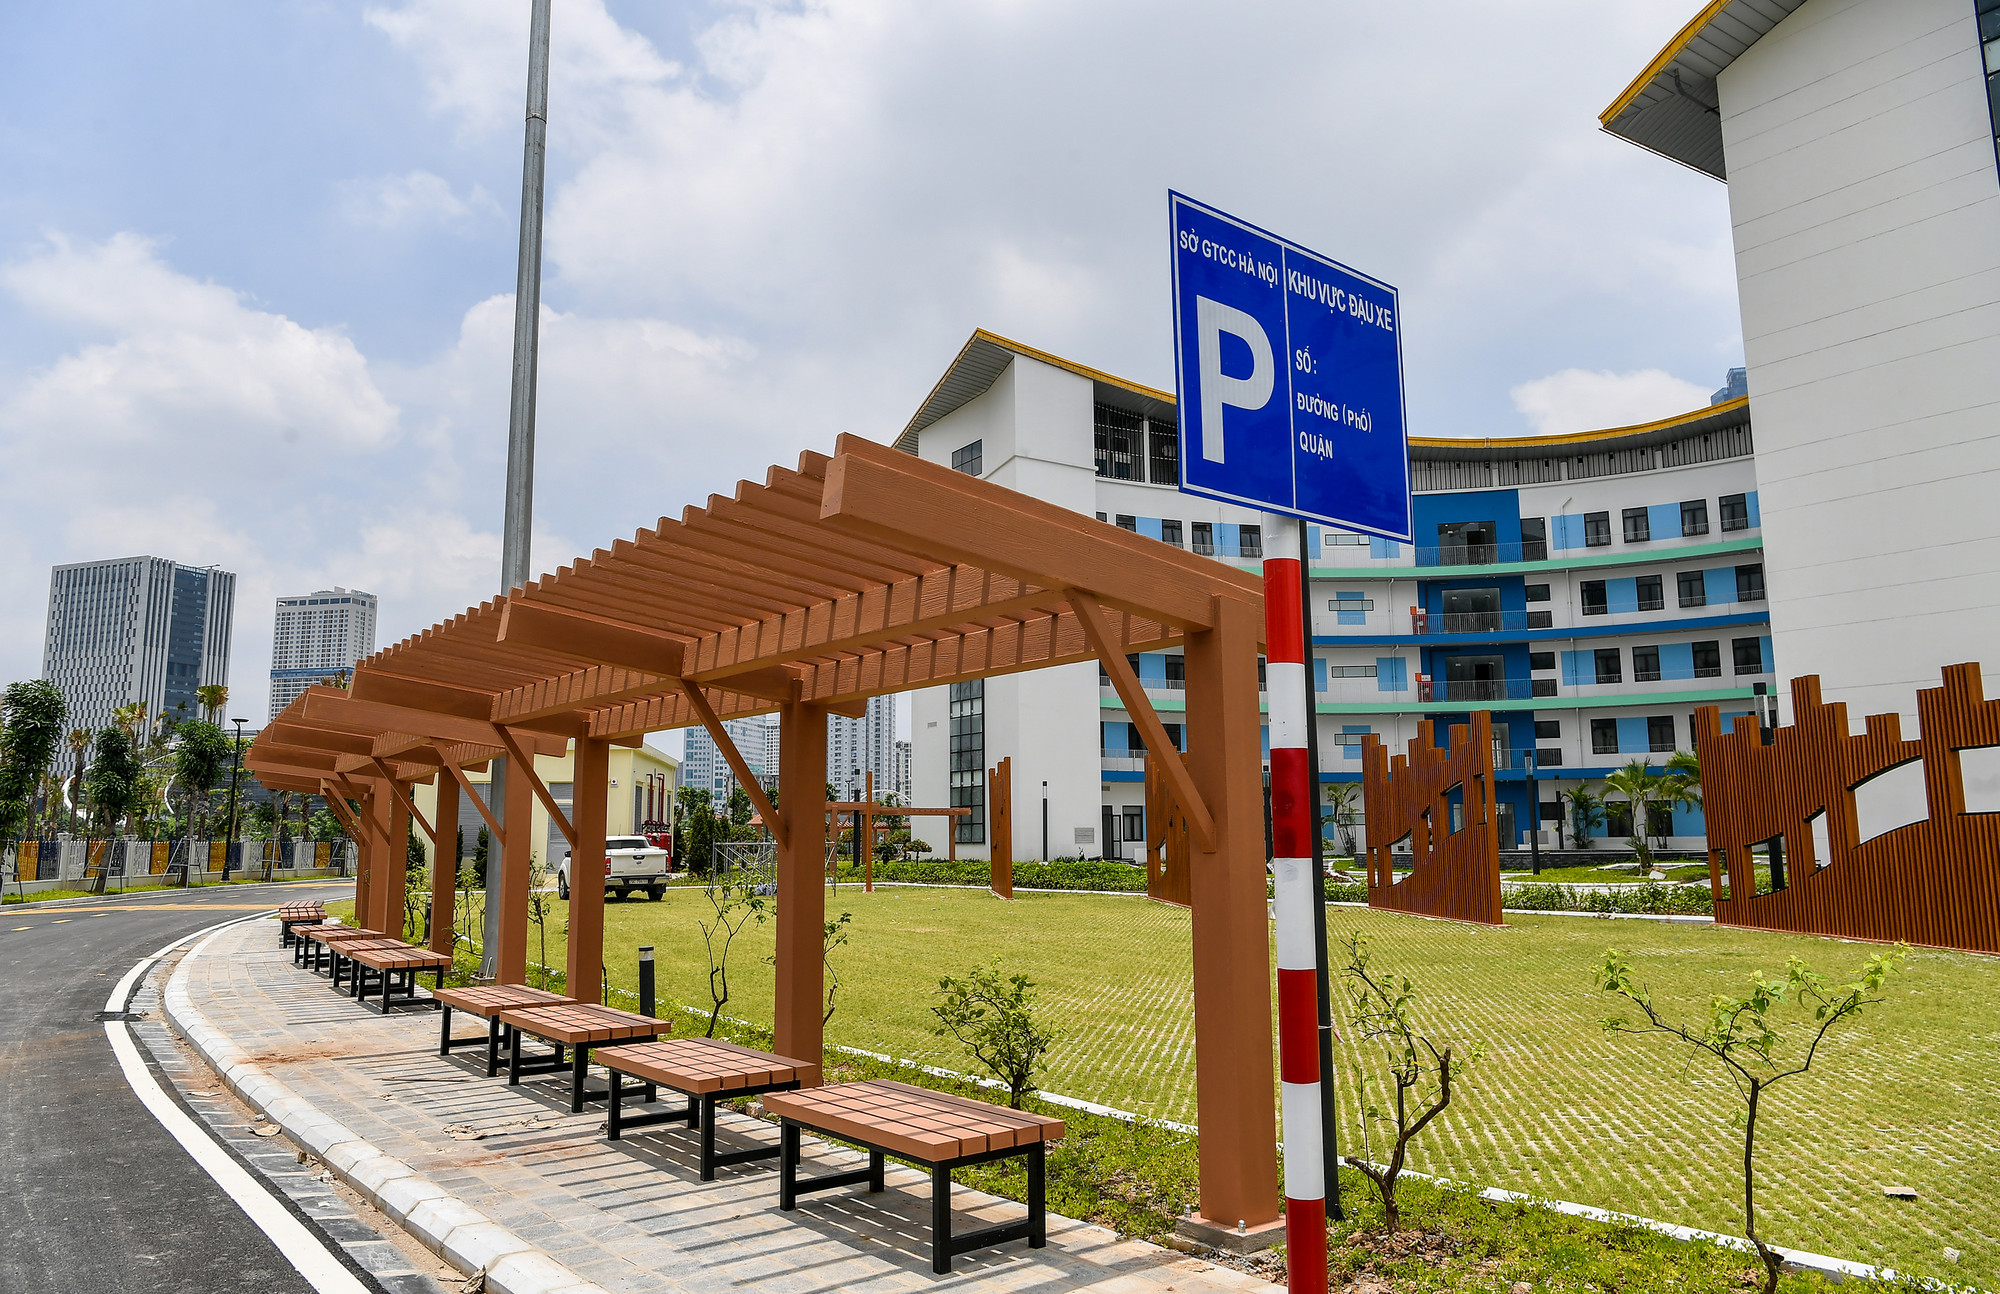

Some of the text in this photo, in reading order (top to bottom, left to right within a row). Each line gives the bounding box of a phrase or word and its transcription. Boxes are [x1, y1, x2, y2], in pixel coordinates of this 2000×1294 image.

[1180, 228, 1278, 288] SỞ GTCC HÀ NỘI
[1288, 268, 1393, 332] KHU VỰC ĐẬU XE
[1196, 294, 1275, 465] P
[1297, 393, 1339, 421] ĐƯỜNG
[1299, 431, 1333, 461] QUẬN
